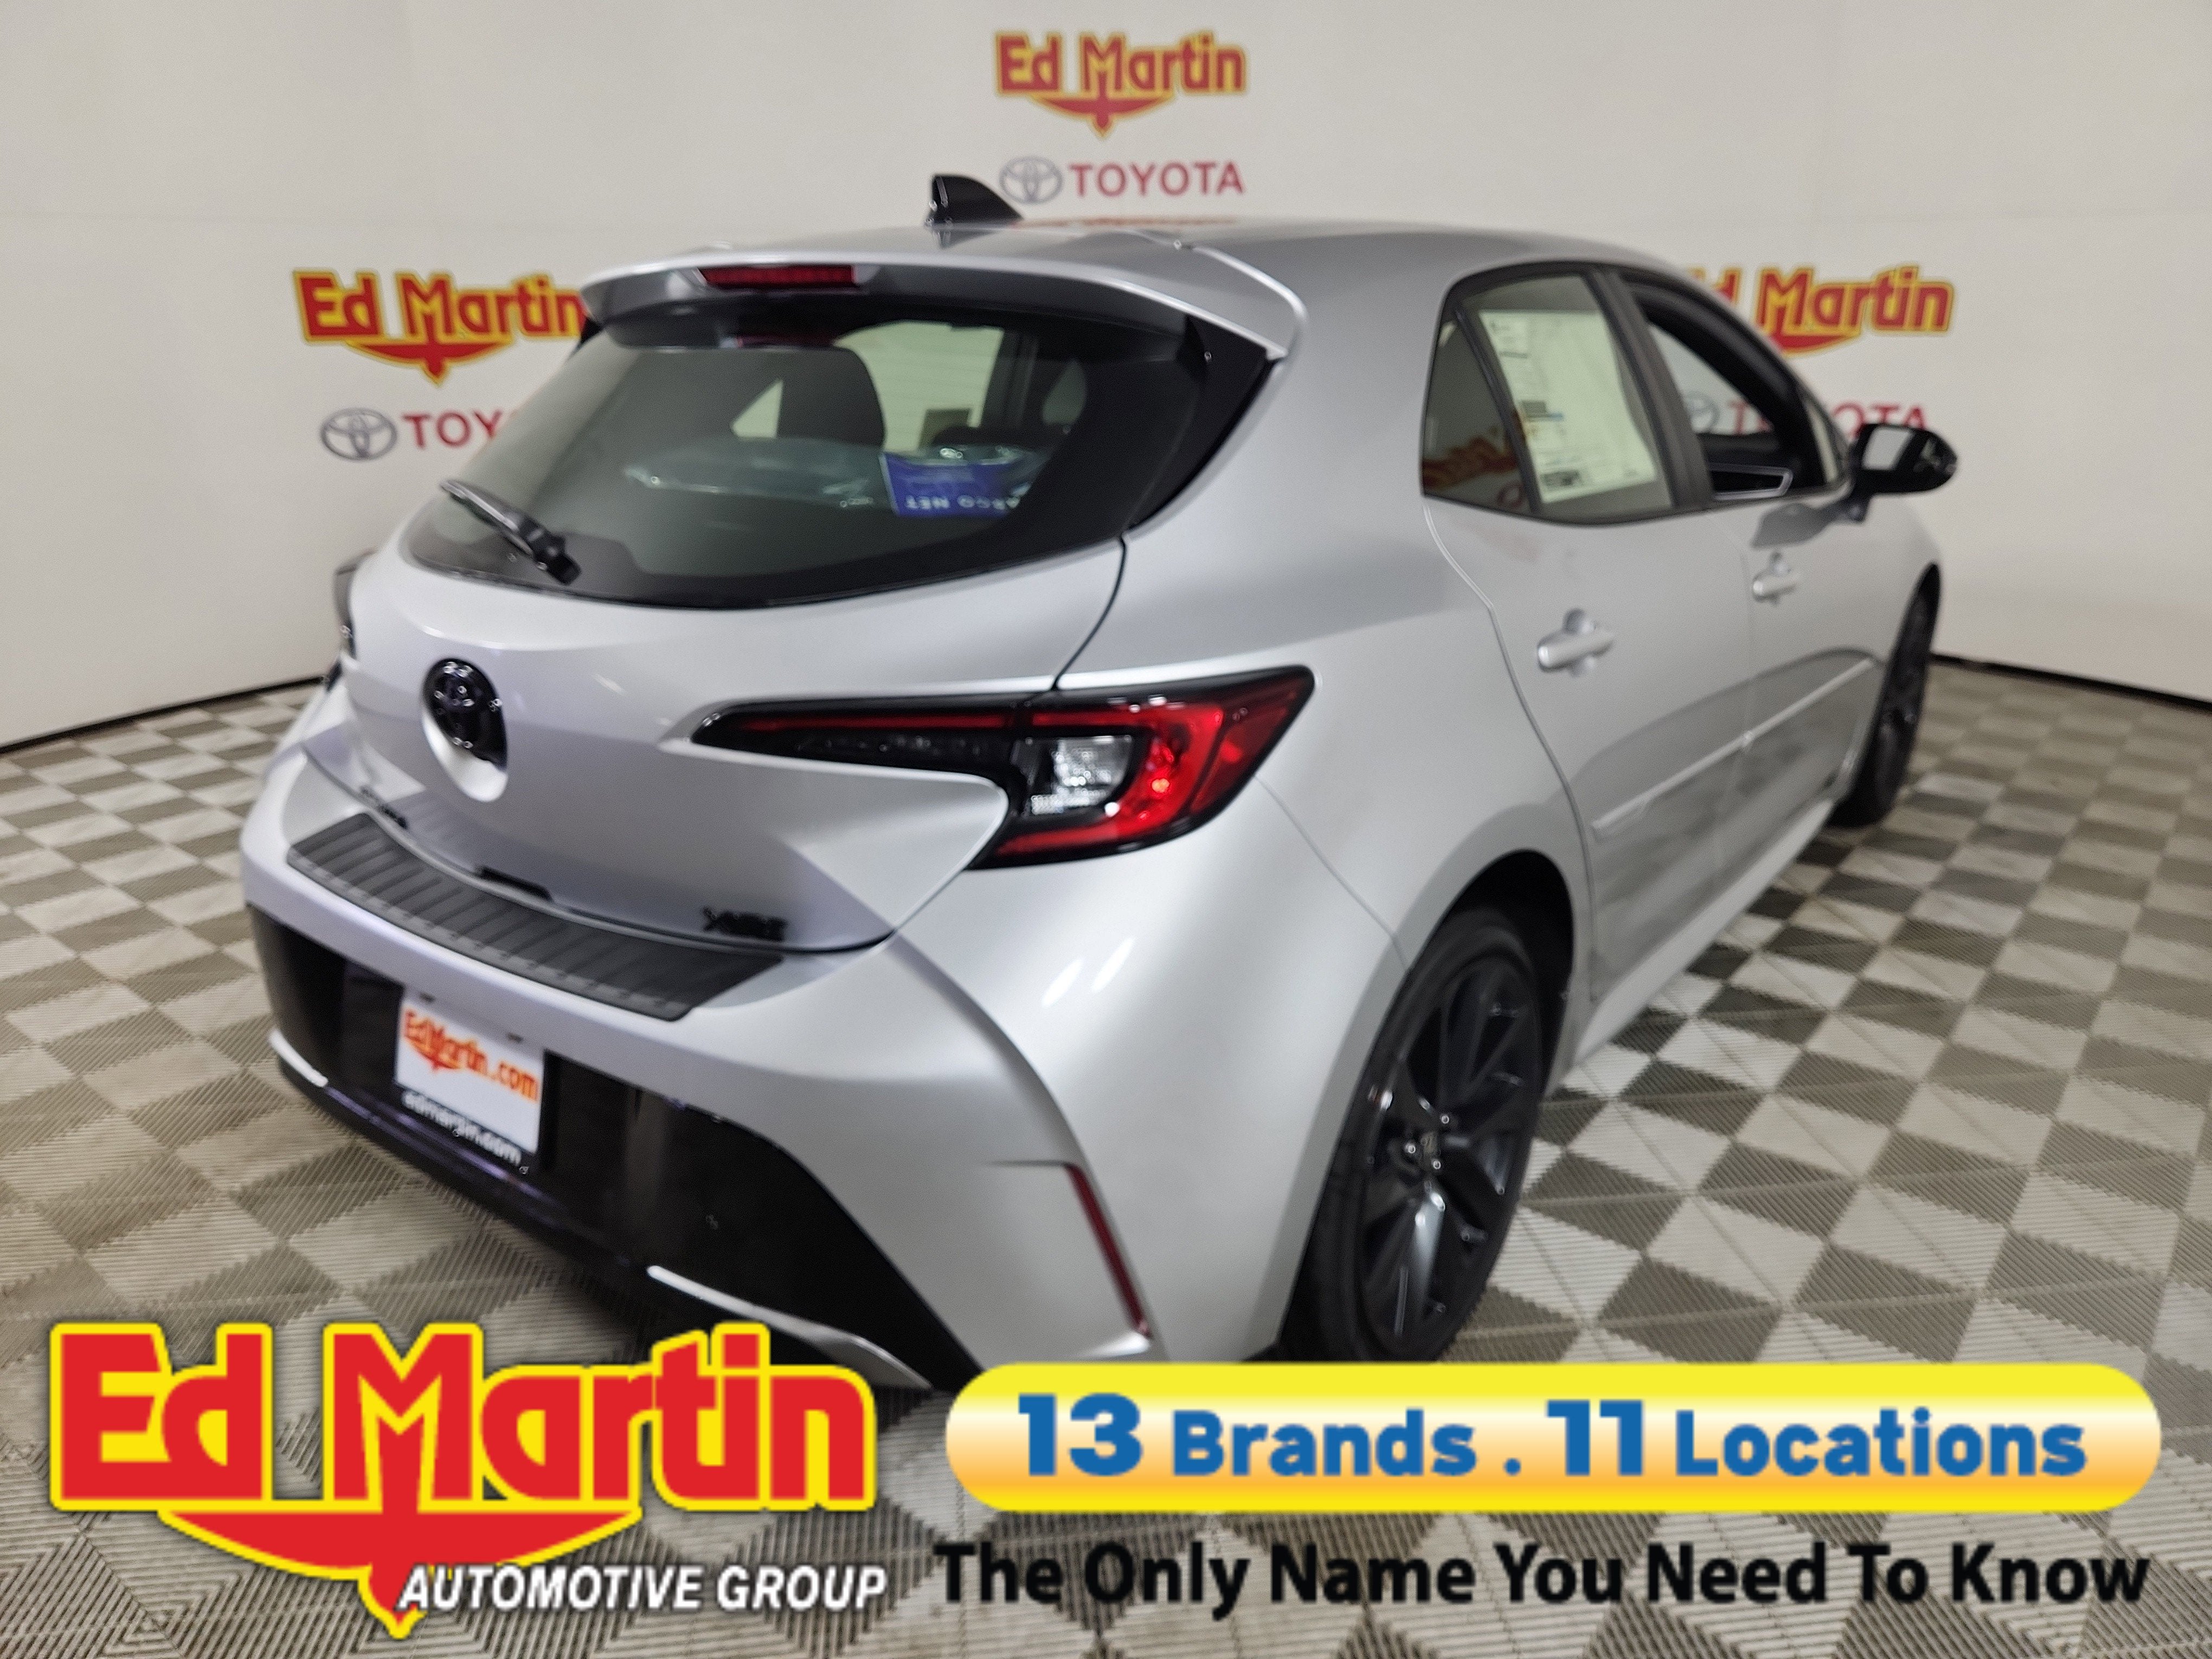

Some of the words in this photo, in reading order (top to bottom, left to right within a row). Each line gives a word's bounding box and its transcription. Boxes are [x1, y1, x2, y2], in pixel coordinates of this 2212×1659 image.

[994, 31, 1062, 95] Ed
[1078, 30, 1246, 96] Martin
[1068, 161, 1244, 198] TOYOTA
[293, 270, 384, 344] Ed
[394, 271, 587, 343] Martin
[1756, 264, 1955, 336] Martin
